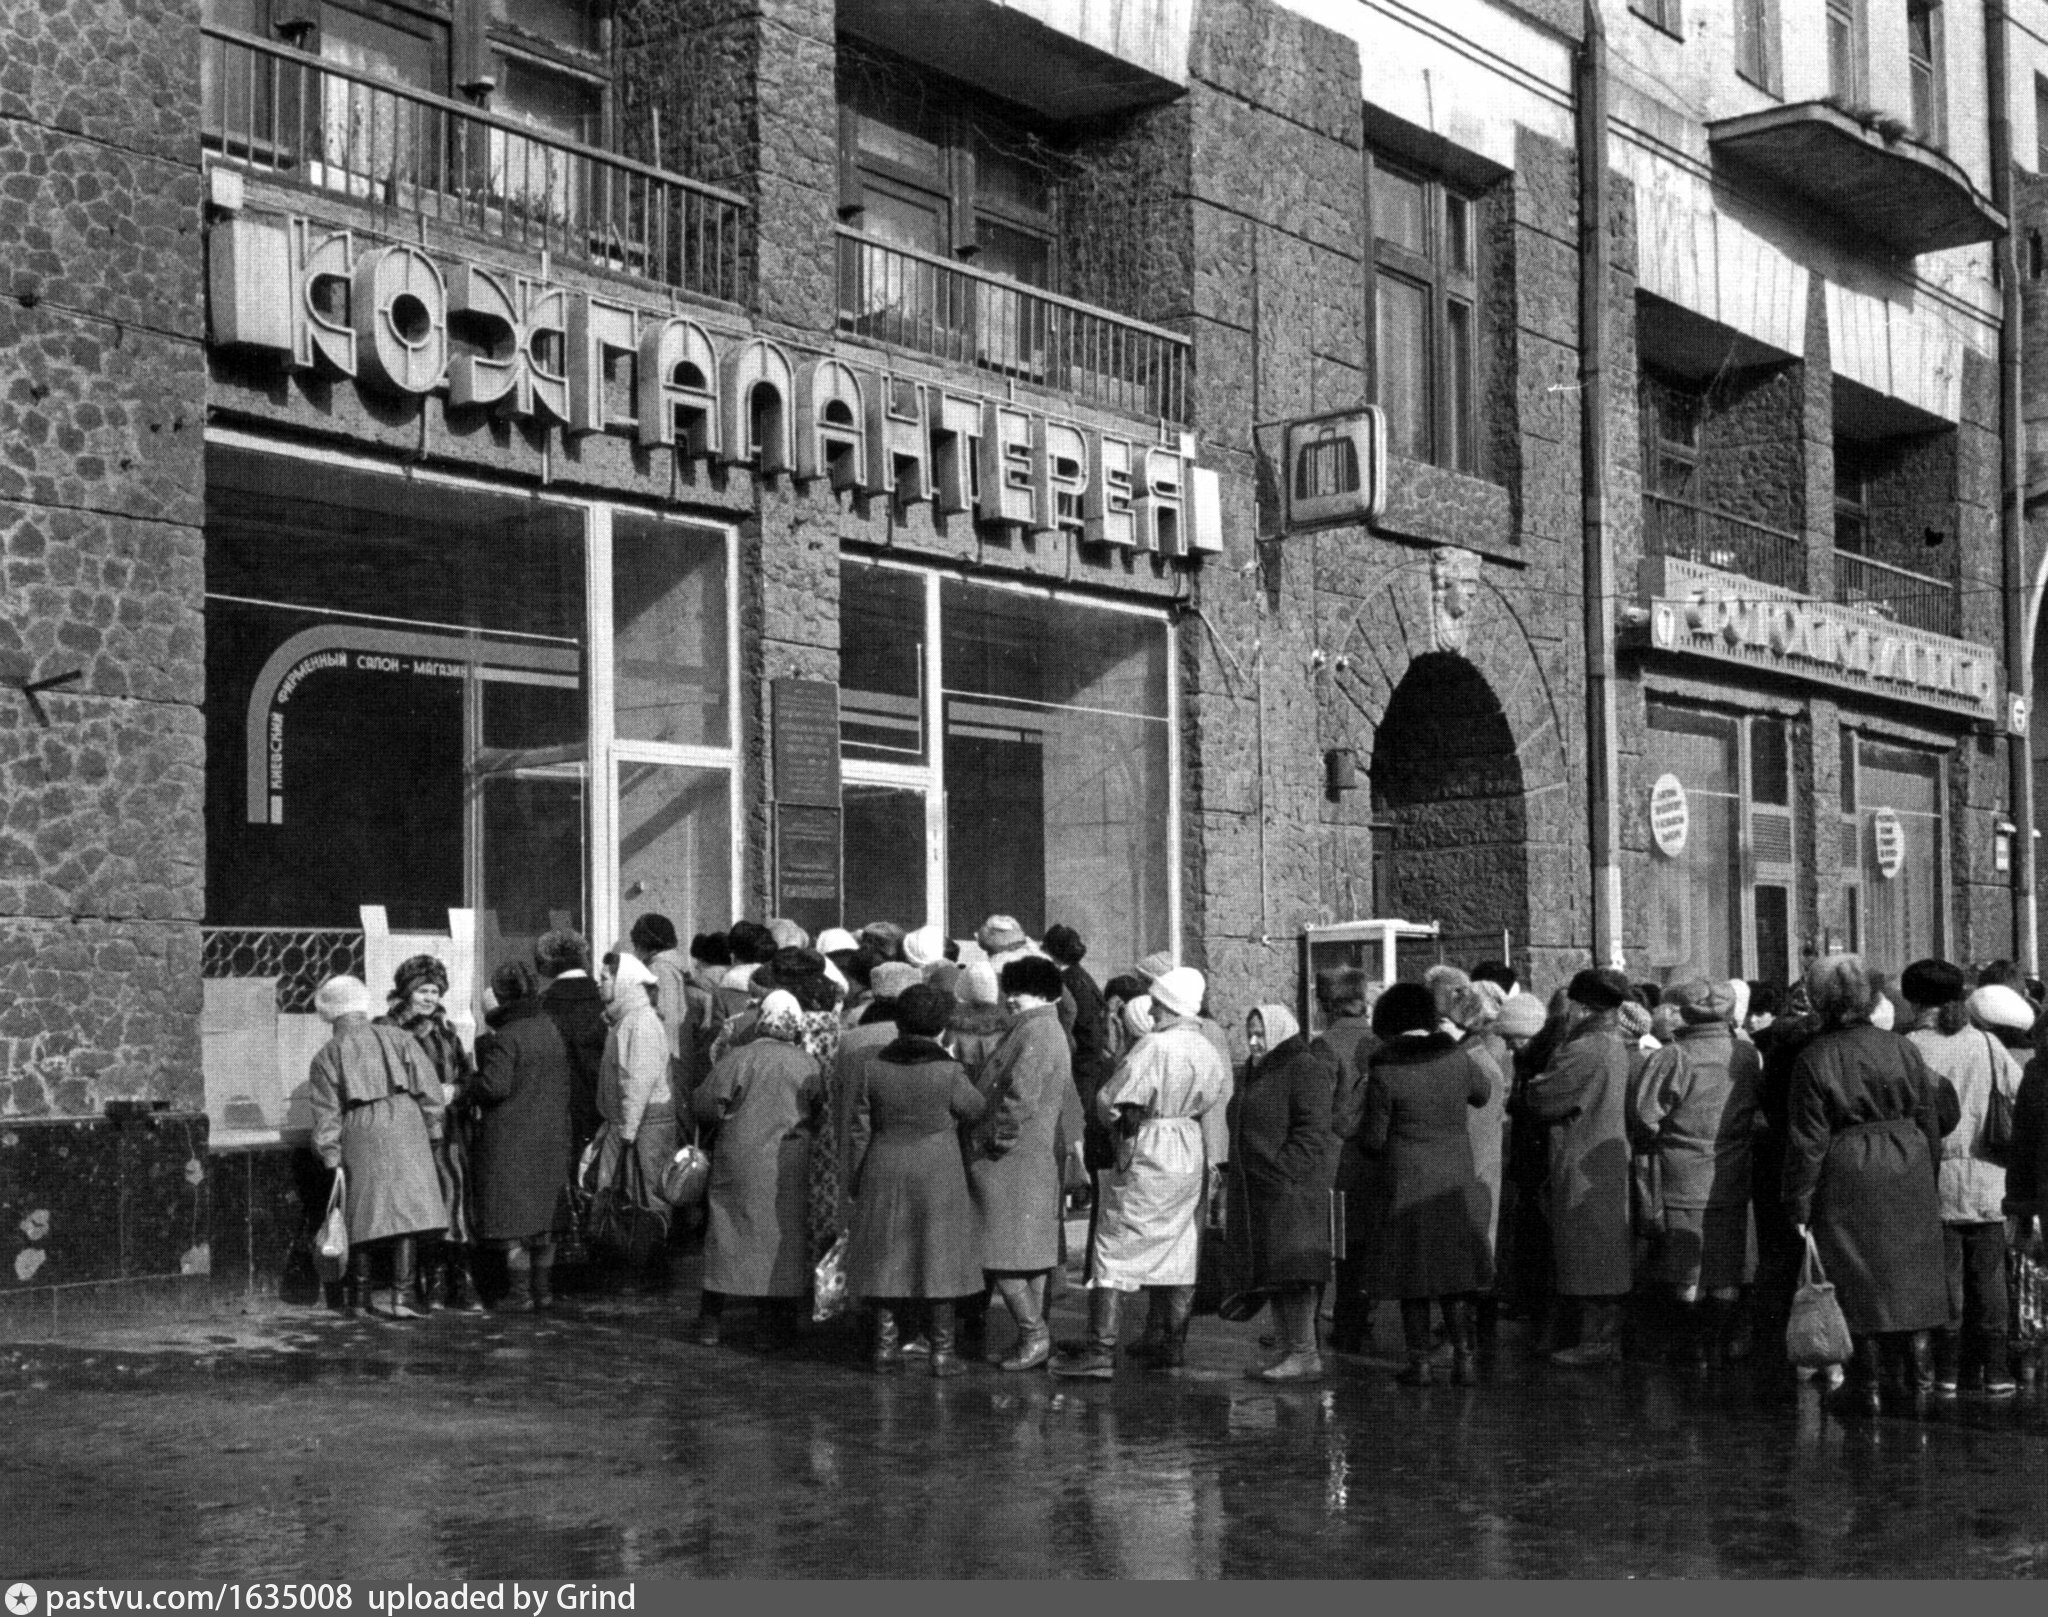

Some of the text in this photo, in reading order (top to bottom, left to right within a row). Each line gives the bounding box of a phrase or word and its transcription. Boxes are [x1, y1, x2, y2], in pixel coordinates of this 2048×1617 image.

[286, 215, 1189, 557] КОЖГАЛАНТЕРЕЯ
[270, 711, 284, 790] КИЕВСКИЙ
[277, 651, 347, 703] ФИРМЕННЫЙ
[357, 655, 399, 672] САЛОН
[413, 661, 468, 679] МАГАЗИН
